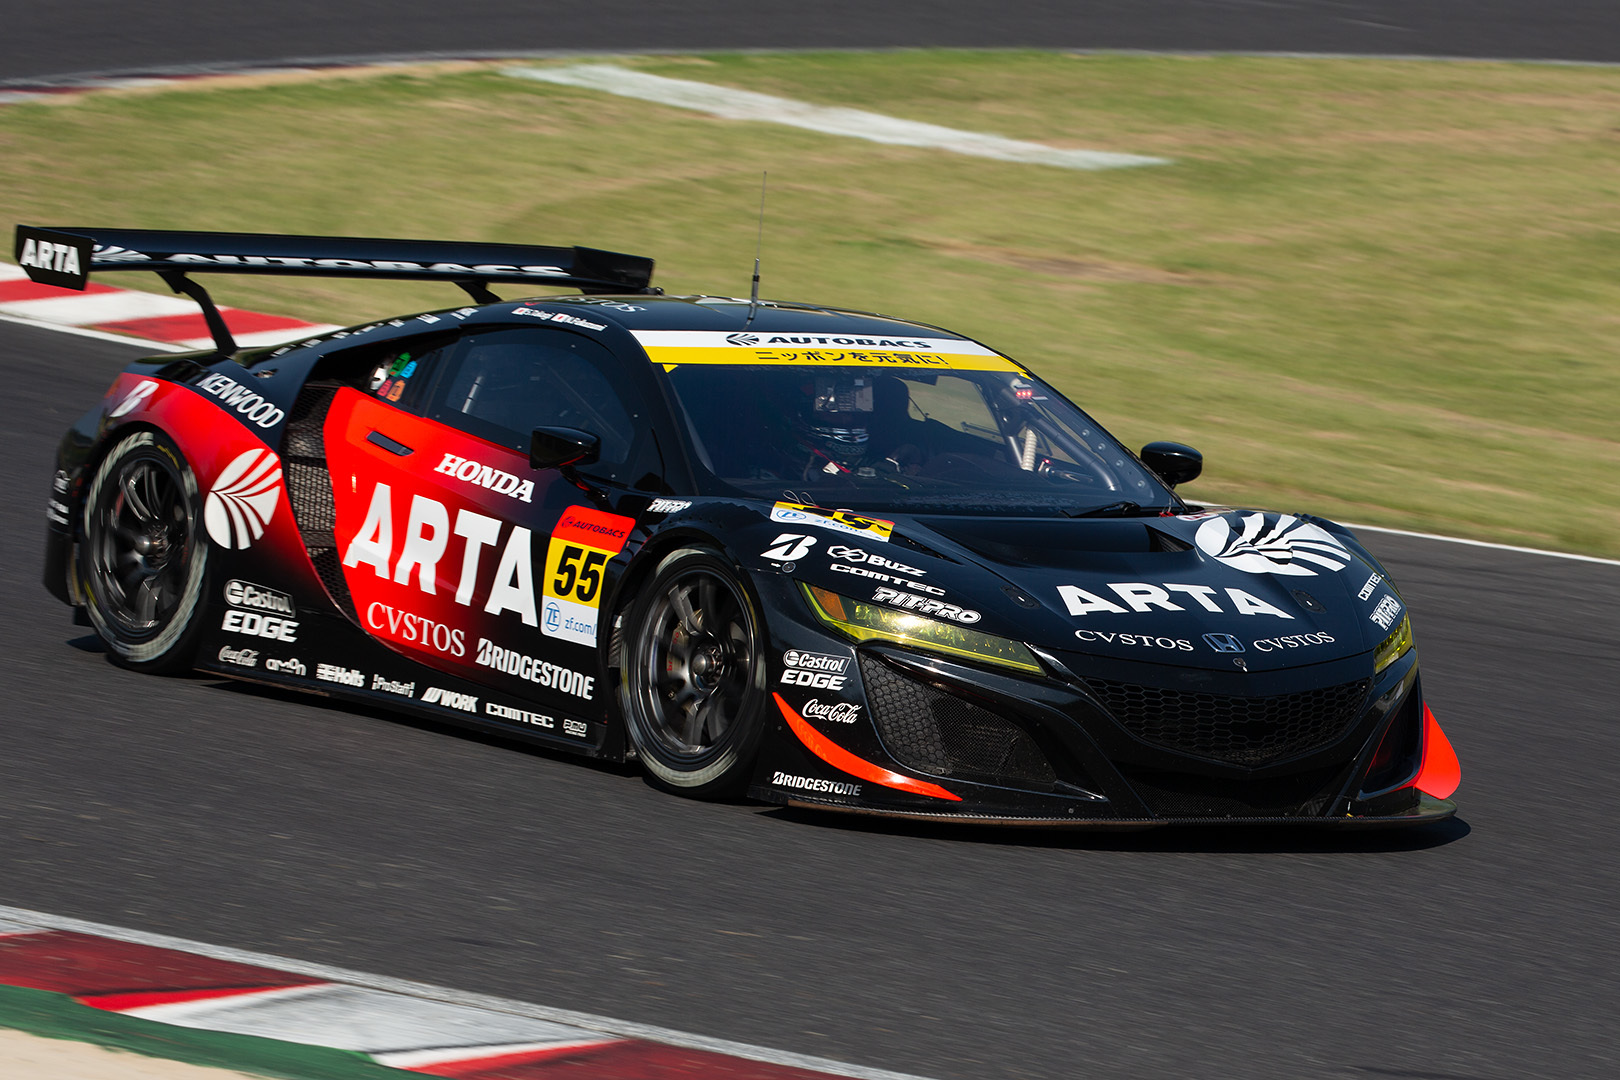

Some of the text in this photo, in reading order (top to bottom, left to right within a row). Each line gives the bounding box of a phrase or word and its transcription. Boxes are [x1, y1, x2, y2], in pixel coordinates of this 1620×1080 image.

[20, 238, 81, 276] ARTA
[767, 336, 932, 349] AUTOBACS
[197, 373, 285, 428] KENWOOD
[434, 453, 536, 503] HONDA
[573, 520, 626, 539] AUTOBACS
[343, 482, 538, 628] ARTA
[553, 545, 608, 603] 55
[830, 563, 946, 597] COMTEC
[242, 586, 292, 613] Castrol
[1056, 583, 1296, 620] ARTA
[221, 610, 300, 643] EDGE
[367, 602, 466, 657] CVSTOS
[1075, 628, 1195, 653] CVSTOS
[1253, 630, 1336, 654] CVSTOS
[475, 637, 595, 701] BRIDGESTONE
[799, 653, 846, 671] Castrol
[780, 669, 848, 690] EDGE
[440, 691, 479, 713] WORK
[485, 702, 555, 729] COMTEC
[772, 771, 862, 797] BRIDGESTONE
